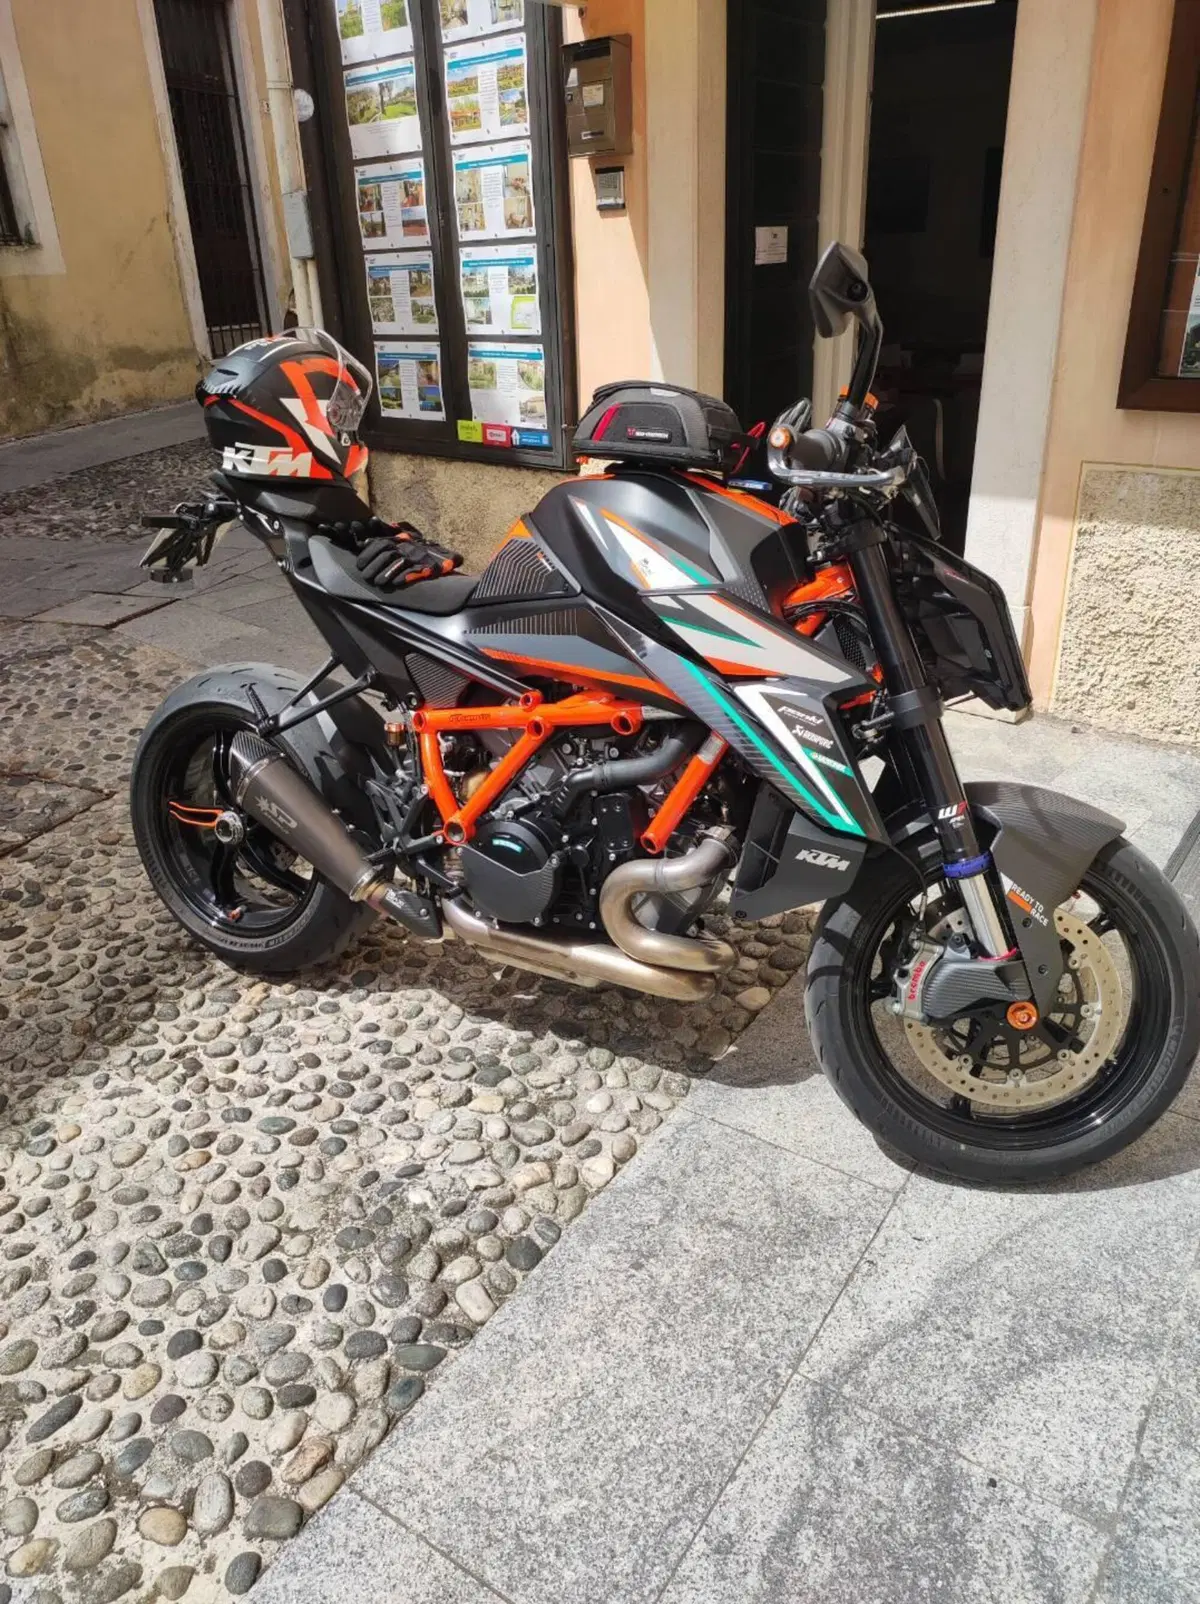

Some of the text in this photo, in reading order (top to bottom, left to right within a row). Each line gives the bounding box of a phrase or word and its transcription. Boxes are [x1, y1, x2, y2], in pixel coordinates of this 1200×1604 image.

[221, 441, 313, 478] KTM
[795, 848, 850, 872] KTM
[1011, 882, 1044, 914] READY TO
[1030, 908, 1049, 927] RACE
[908, 961, 926, 1000] brembo
